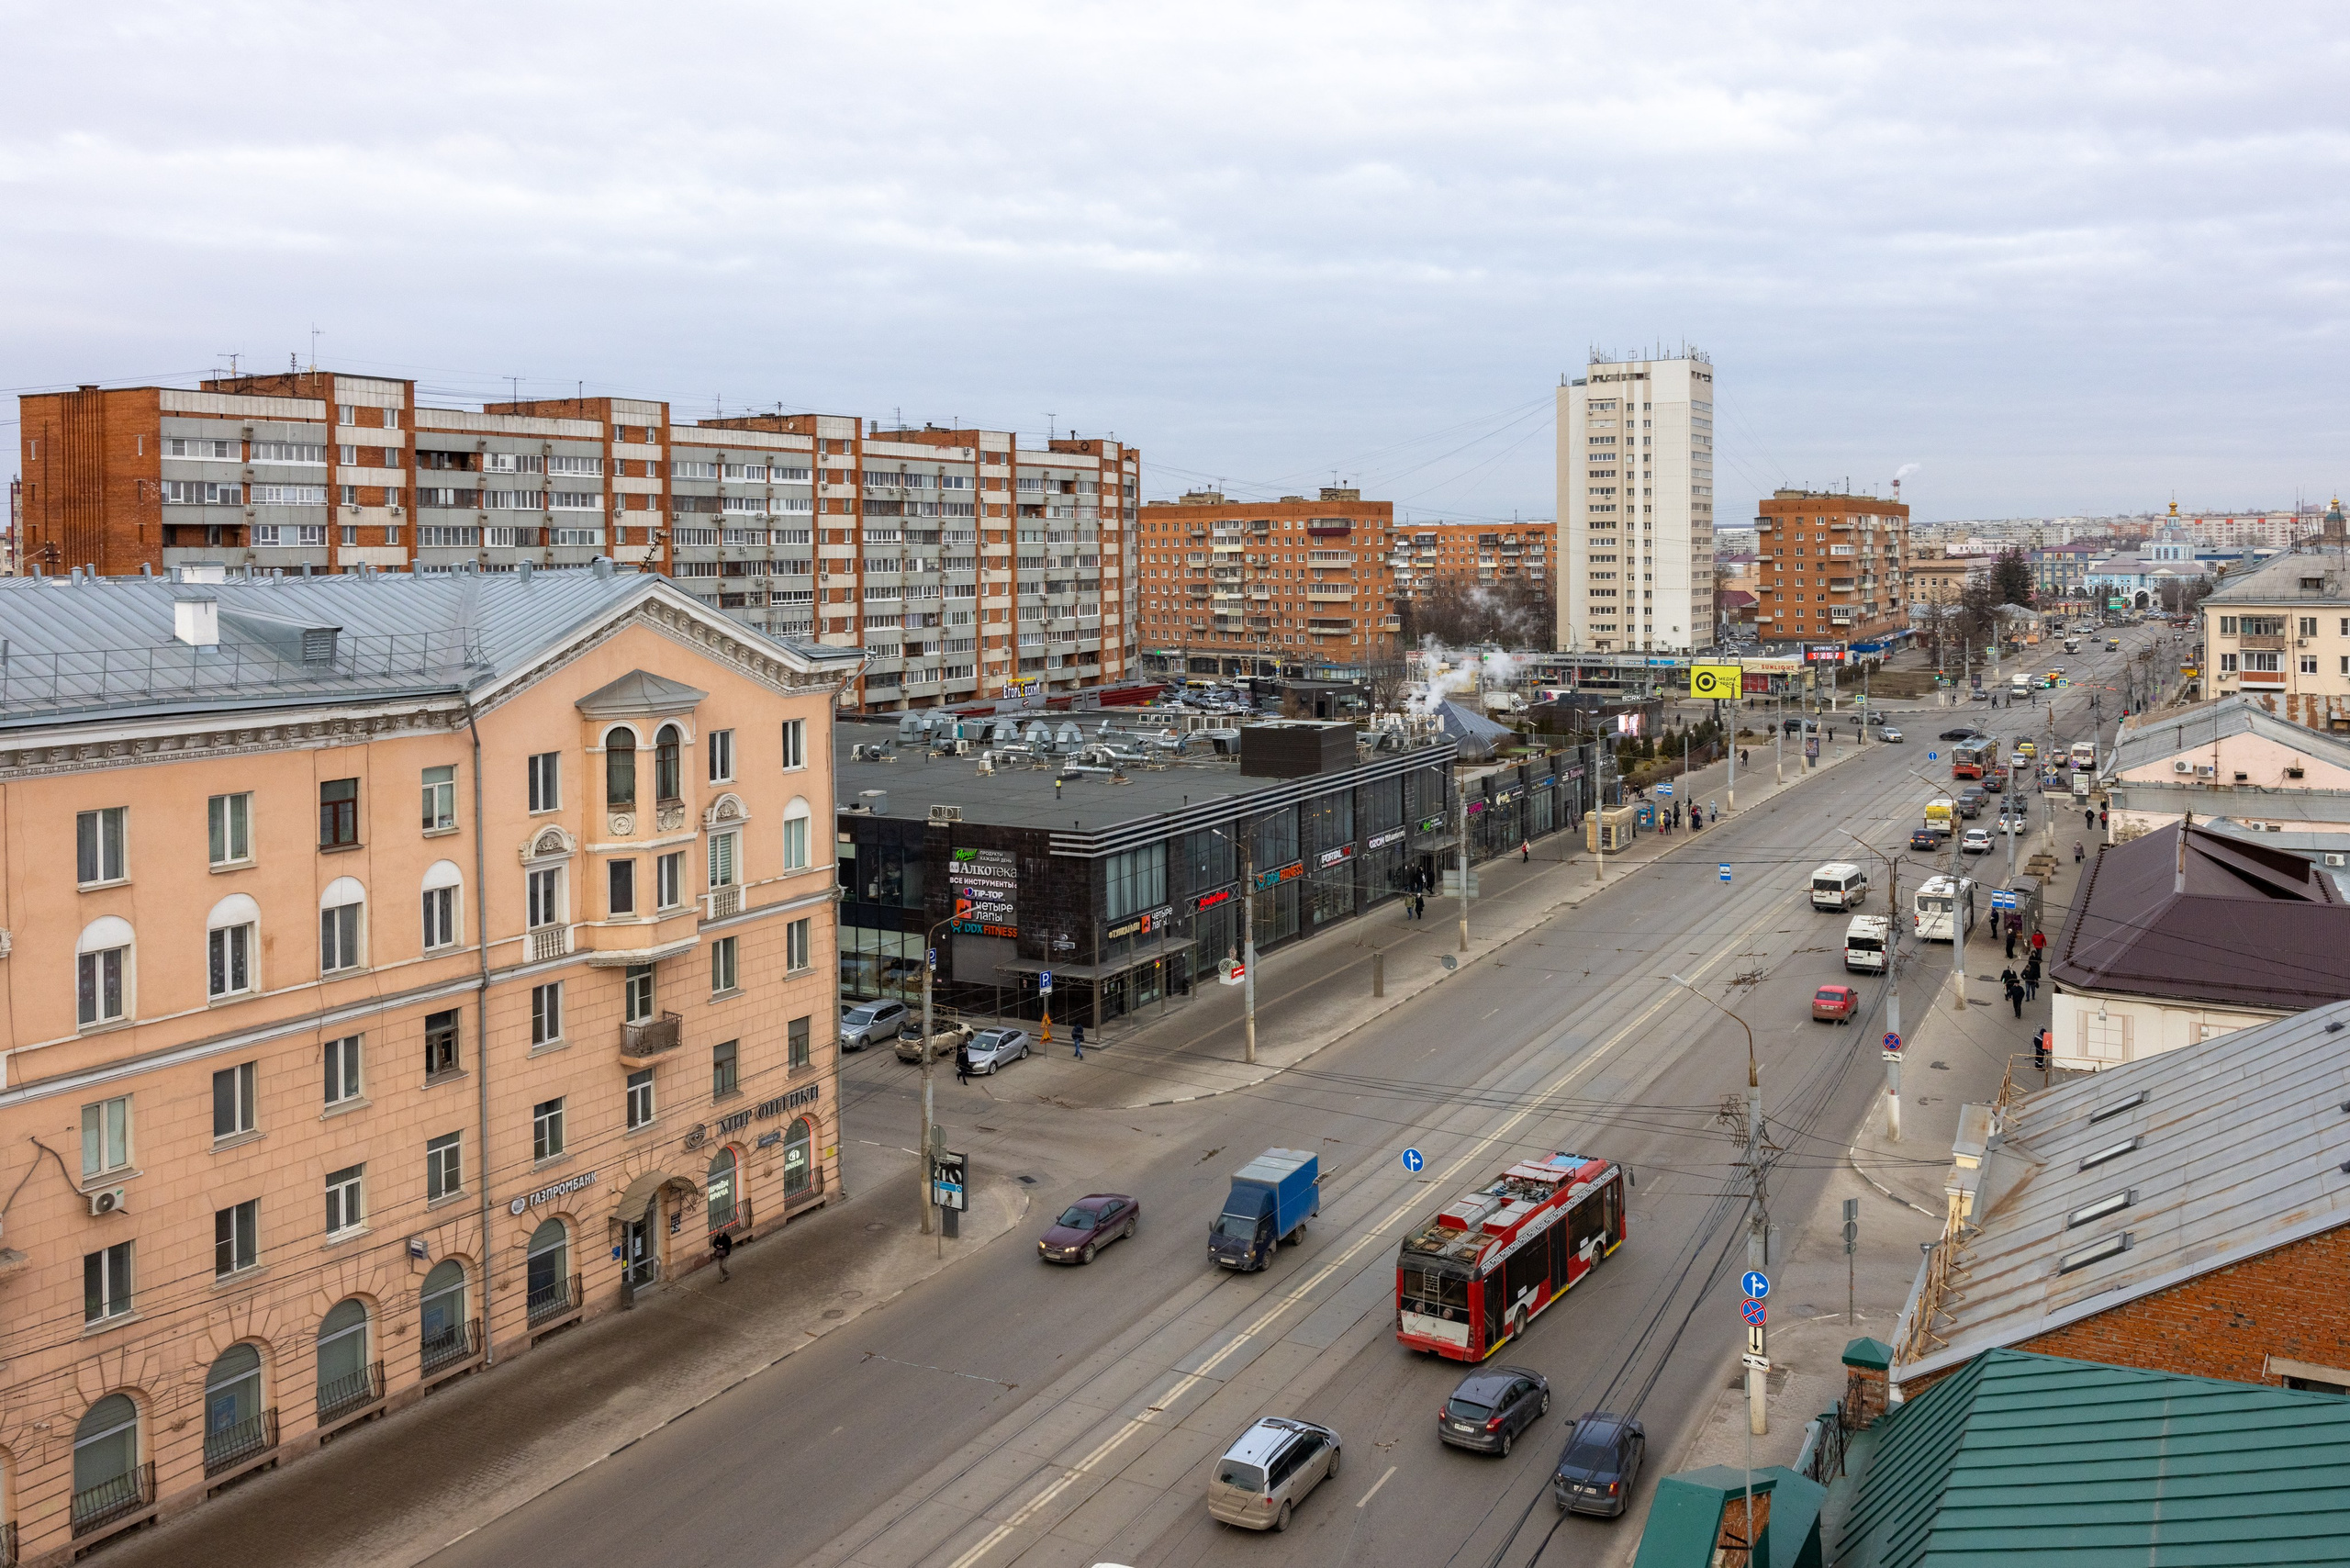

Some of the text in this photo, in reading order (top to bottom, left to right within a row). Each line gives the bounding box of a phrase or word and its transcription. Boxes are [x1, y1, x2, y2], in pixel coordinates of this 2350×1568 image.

[1621, 694, 1641, 702] BORK
[1322, 848, 1342, 864] PORTAL
[964, 923, 1018, 937] DDX FITNESS
[718, 1083, 820, 1136] МИР ОПТИКИ
[529, 1171, 598, 1207] ГАЗПРОМБАНК
